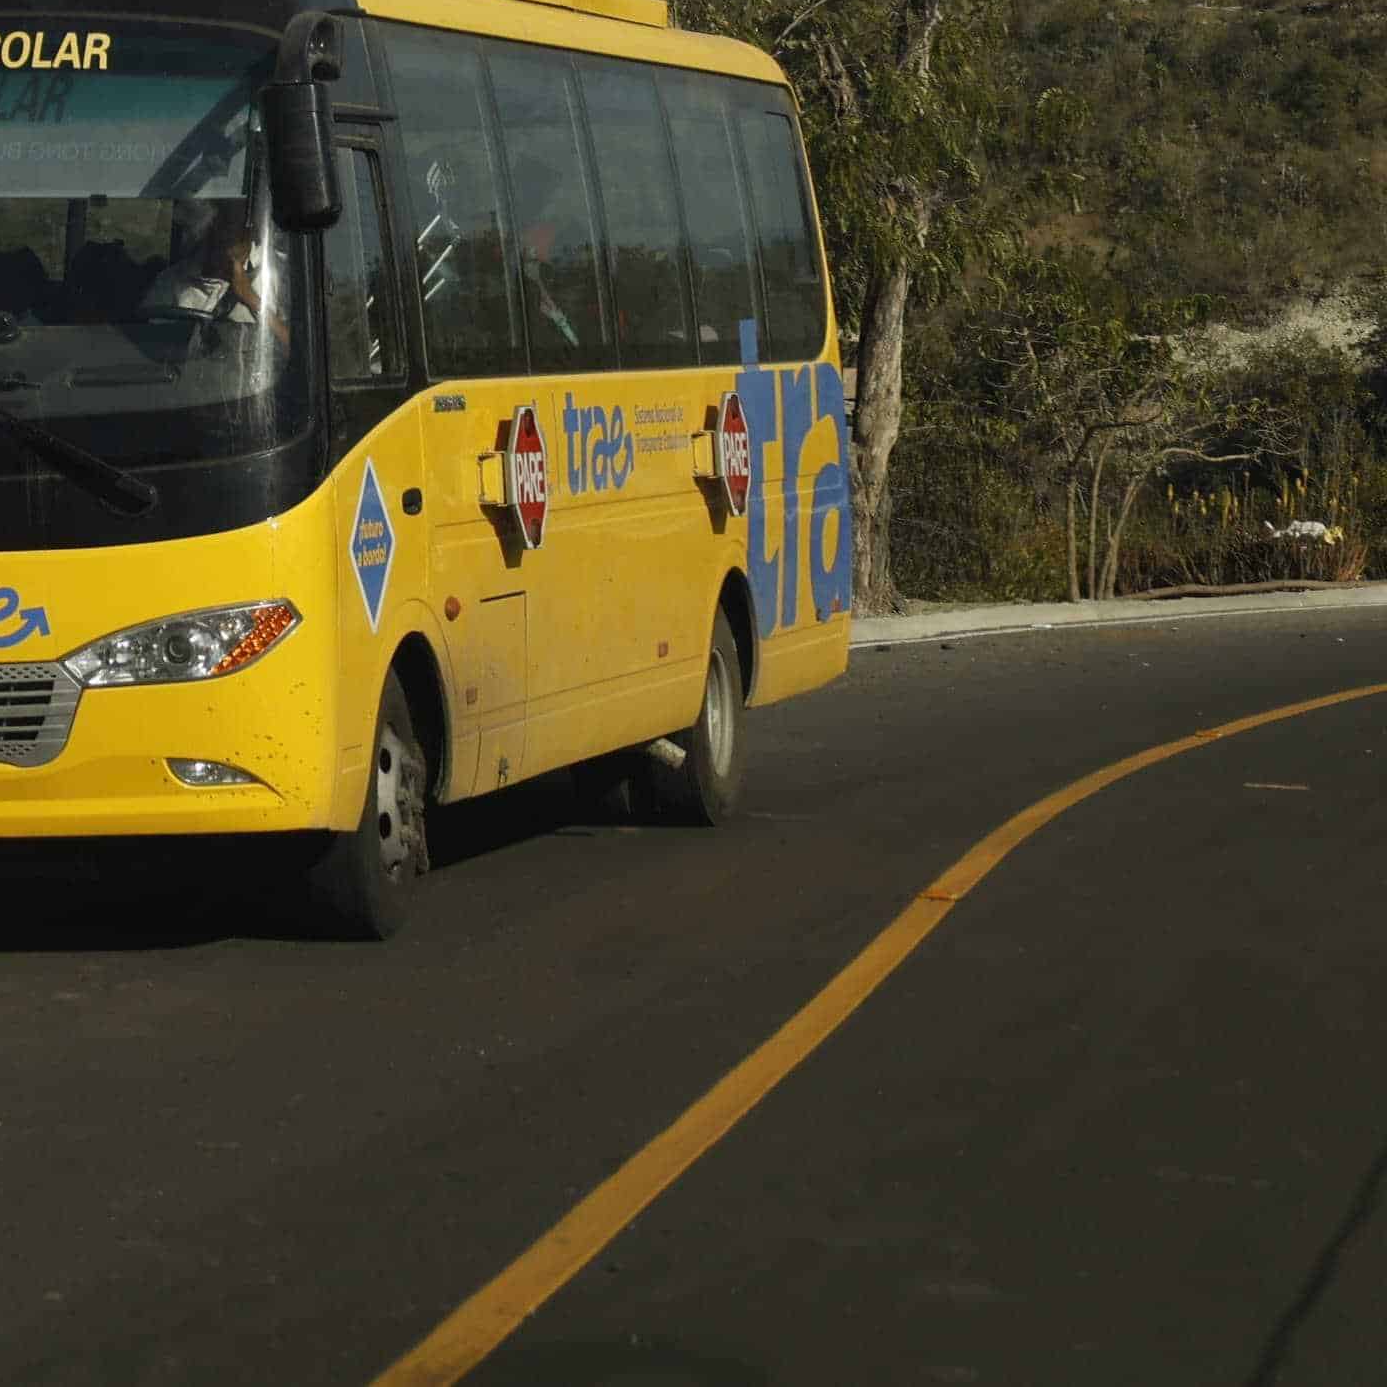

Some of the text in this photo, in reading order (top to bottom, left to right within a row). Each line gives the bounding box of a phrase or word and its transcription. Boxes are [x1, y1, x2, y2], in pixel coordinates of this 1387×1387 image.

[563, 392, 634, 495] trae
[724, 432, 748, 476] PARE
[517, 453, 545, 503] PARE
